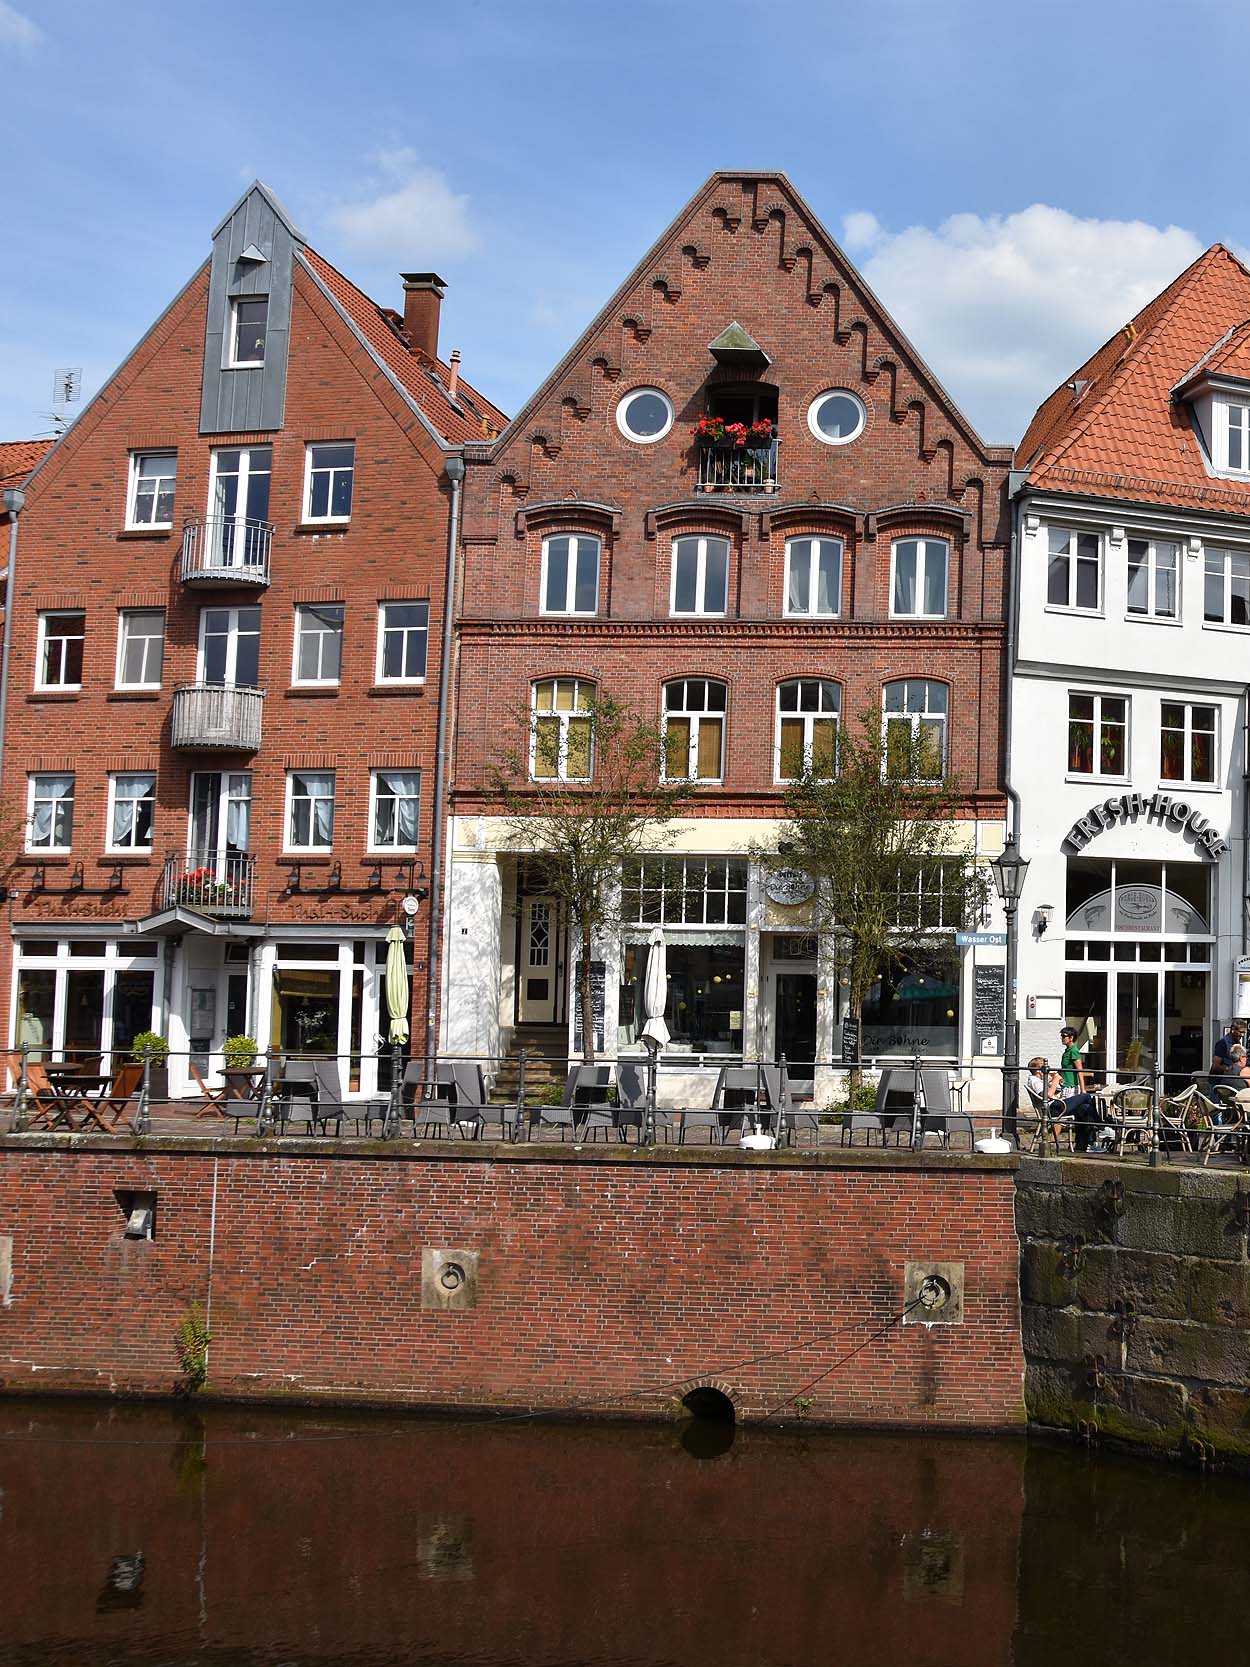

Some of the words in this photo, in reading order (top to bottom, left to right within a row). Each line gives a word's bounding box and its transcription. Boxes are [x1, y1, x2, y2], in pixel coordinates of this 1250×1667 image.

[1065, 793, 1227, 858] FRESH-HOUSE
[961, 935, 987, 943] Wasser
[989, 935, 1002, 943] Ost
